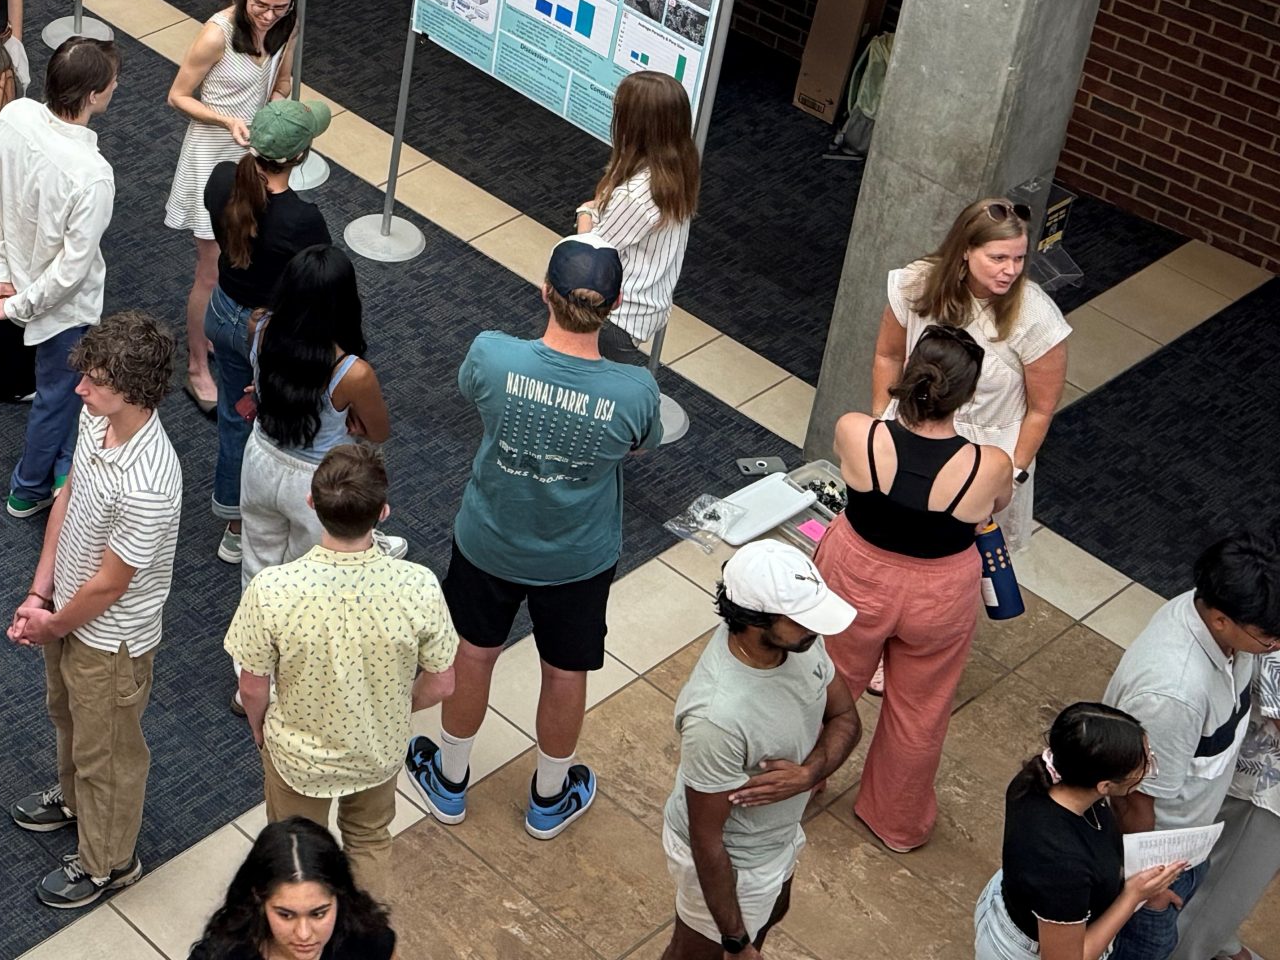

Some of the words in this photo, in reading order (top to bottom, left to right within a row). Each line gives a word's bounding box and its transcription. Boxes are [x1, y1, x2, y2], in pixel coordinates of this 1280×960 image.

[520, 43, 548, 64] Discussion
[506, 371, 554, 406] NATIONAL
[554, 386, 590, 417] PARKS.
[594, 397, 616, 422] USA
[496, 458, 530, 477] PARKS
